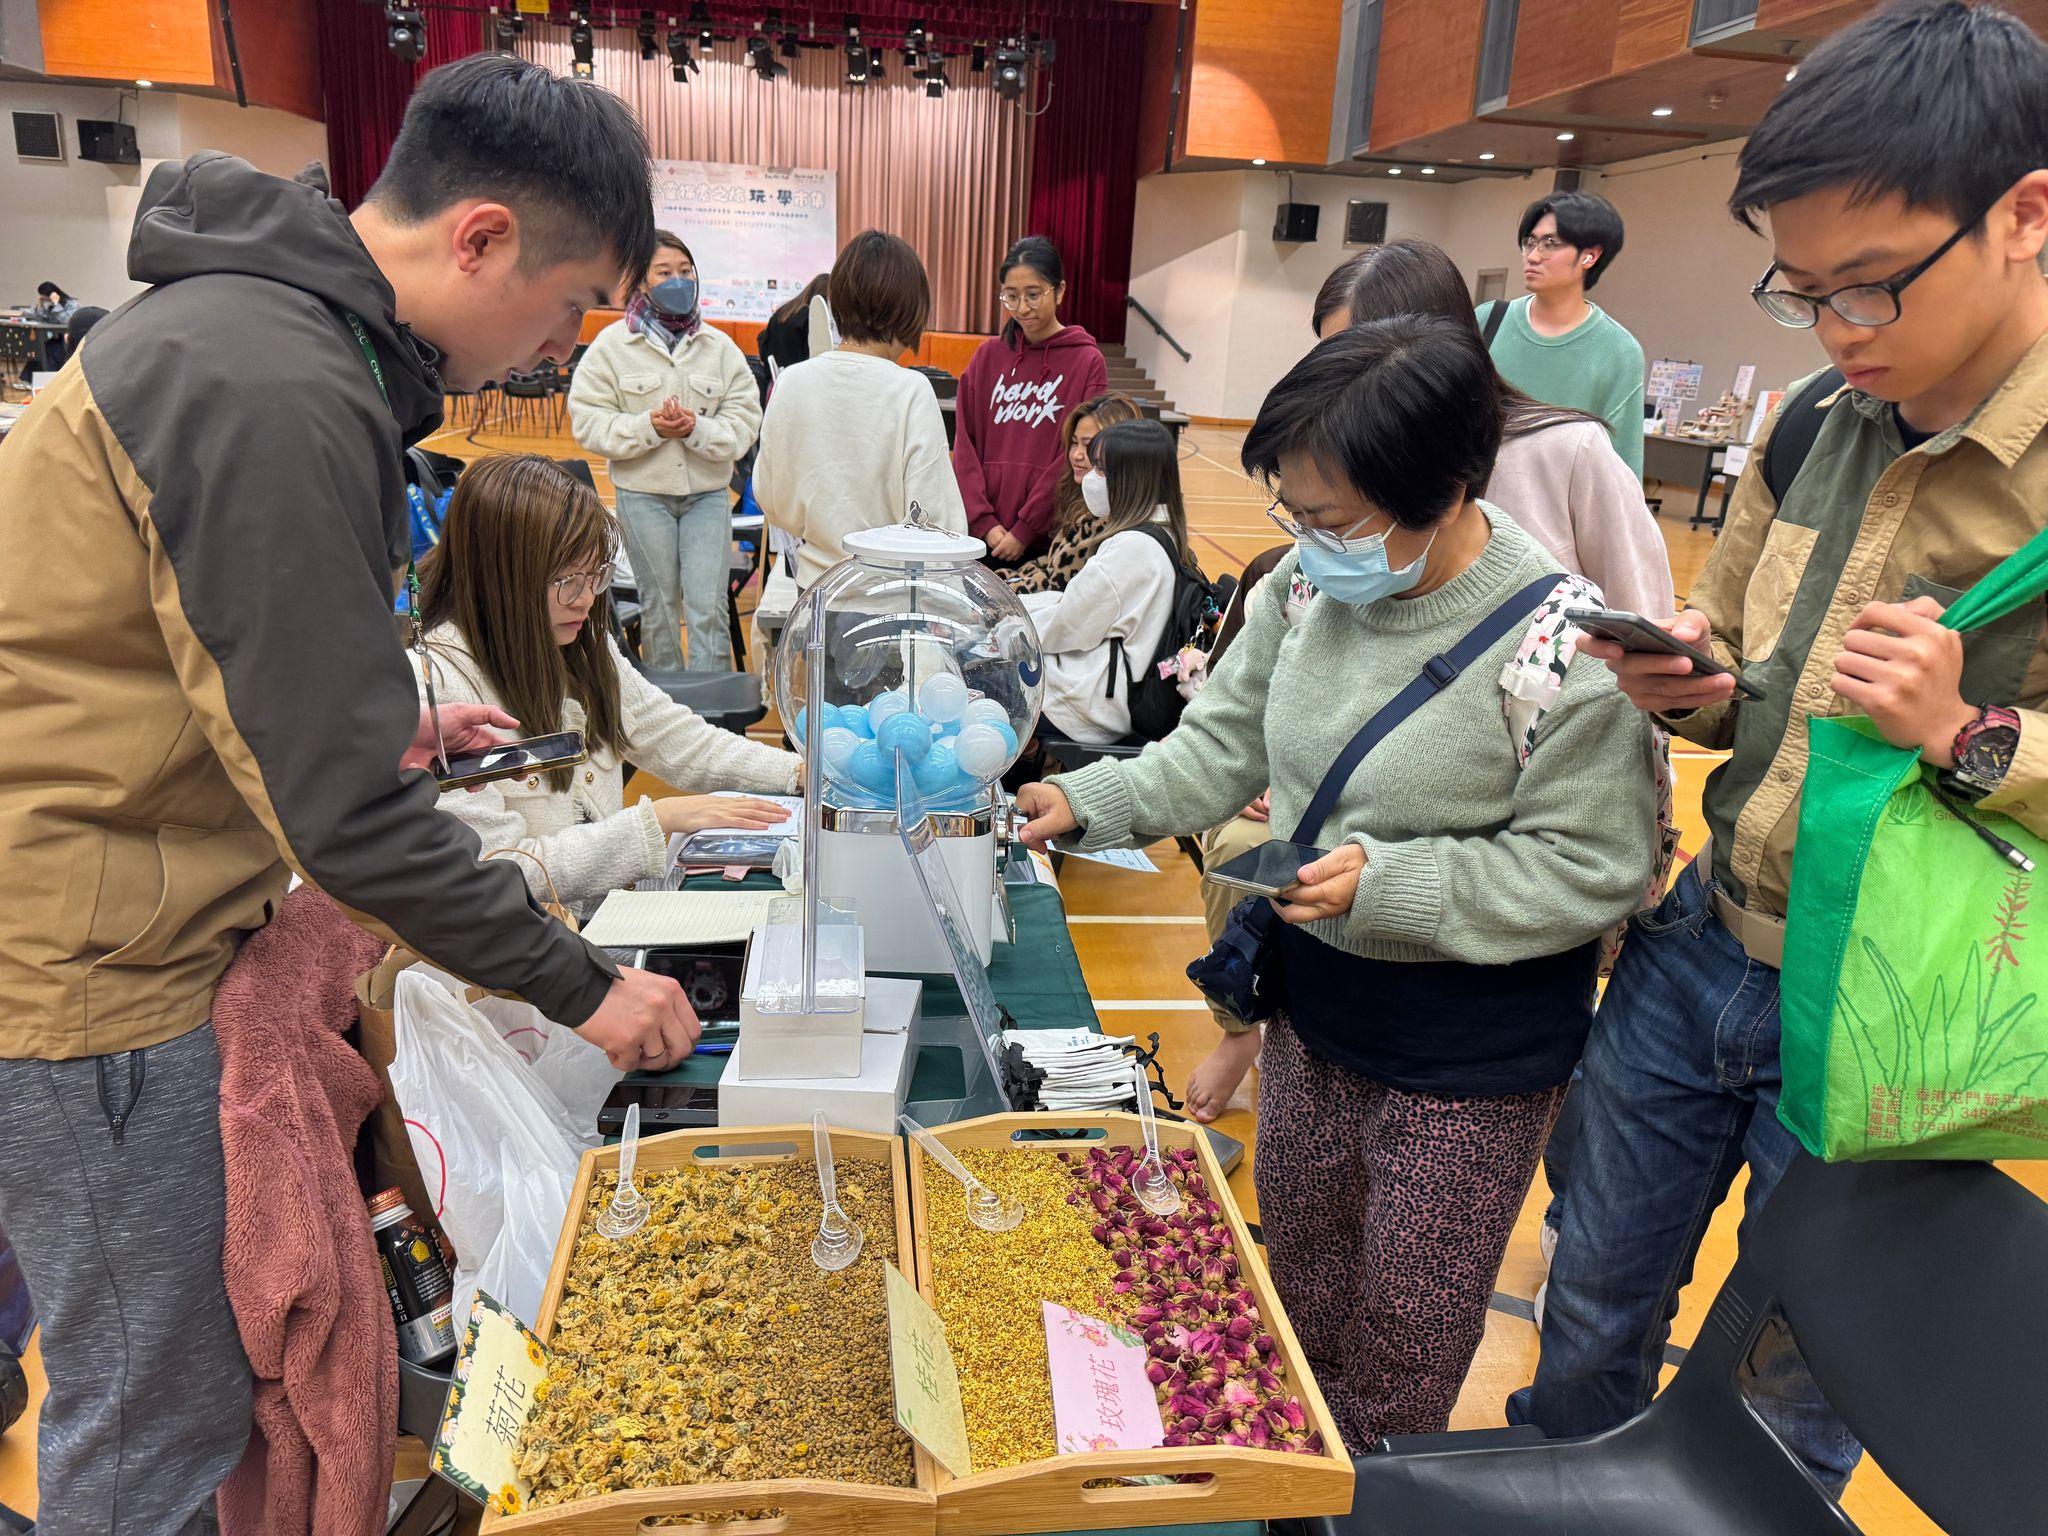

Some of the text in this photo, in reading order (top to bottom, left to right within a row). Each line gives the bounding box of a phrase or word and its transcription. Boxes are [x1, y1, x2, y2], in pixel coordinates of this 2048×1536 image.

[989, 373, 1064, 411] hard
[993, 395, 1066, 429] work
[911, 1328, 940, 1404] 桂花
[1088, 1353, 1126, 1432] 玫瑰花
[485, 1364, 526, 1450] 菊花
